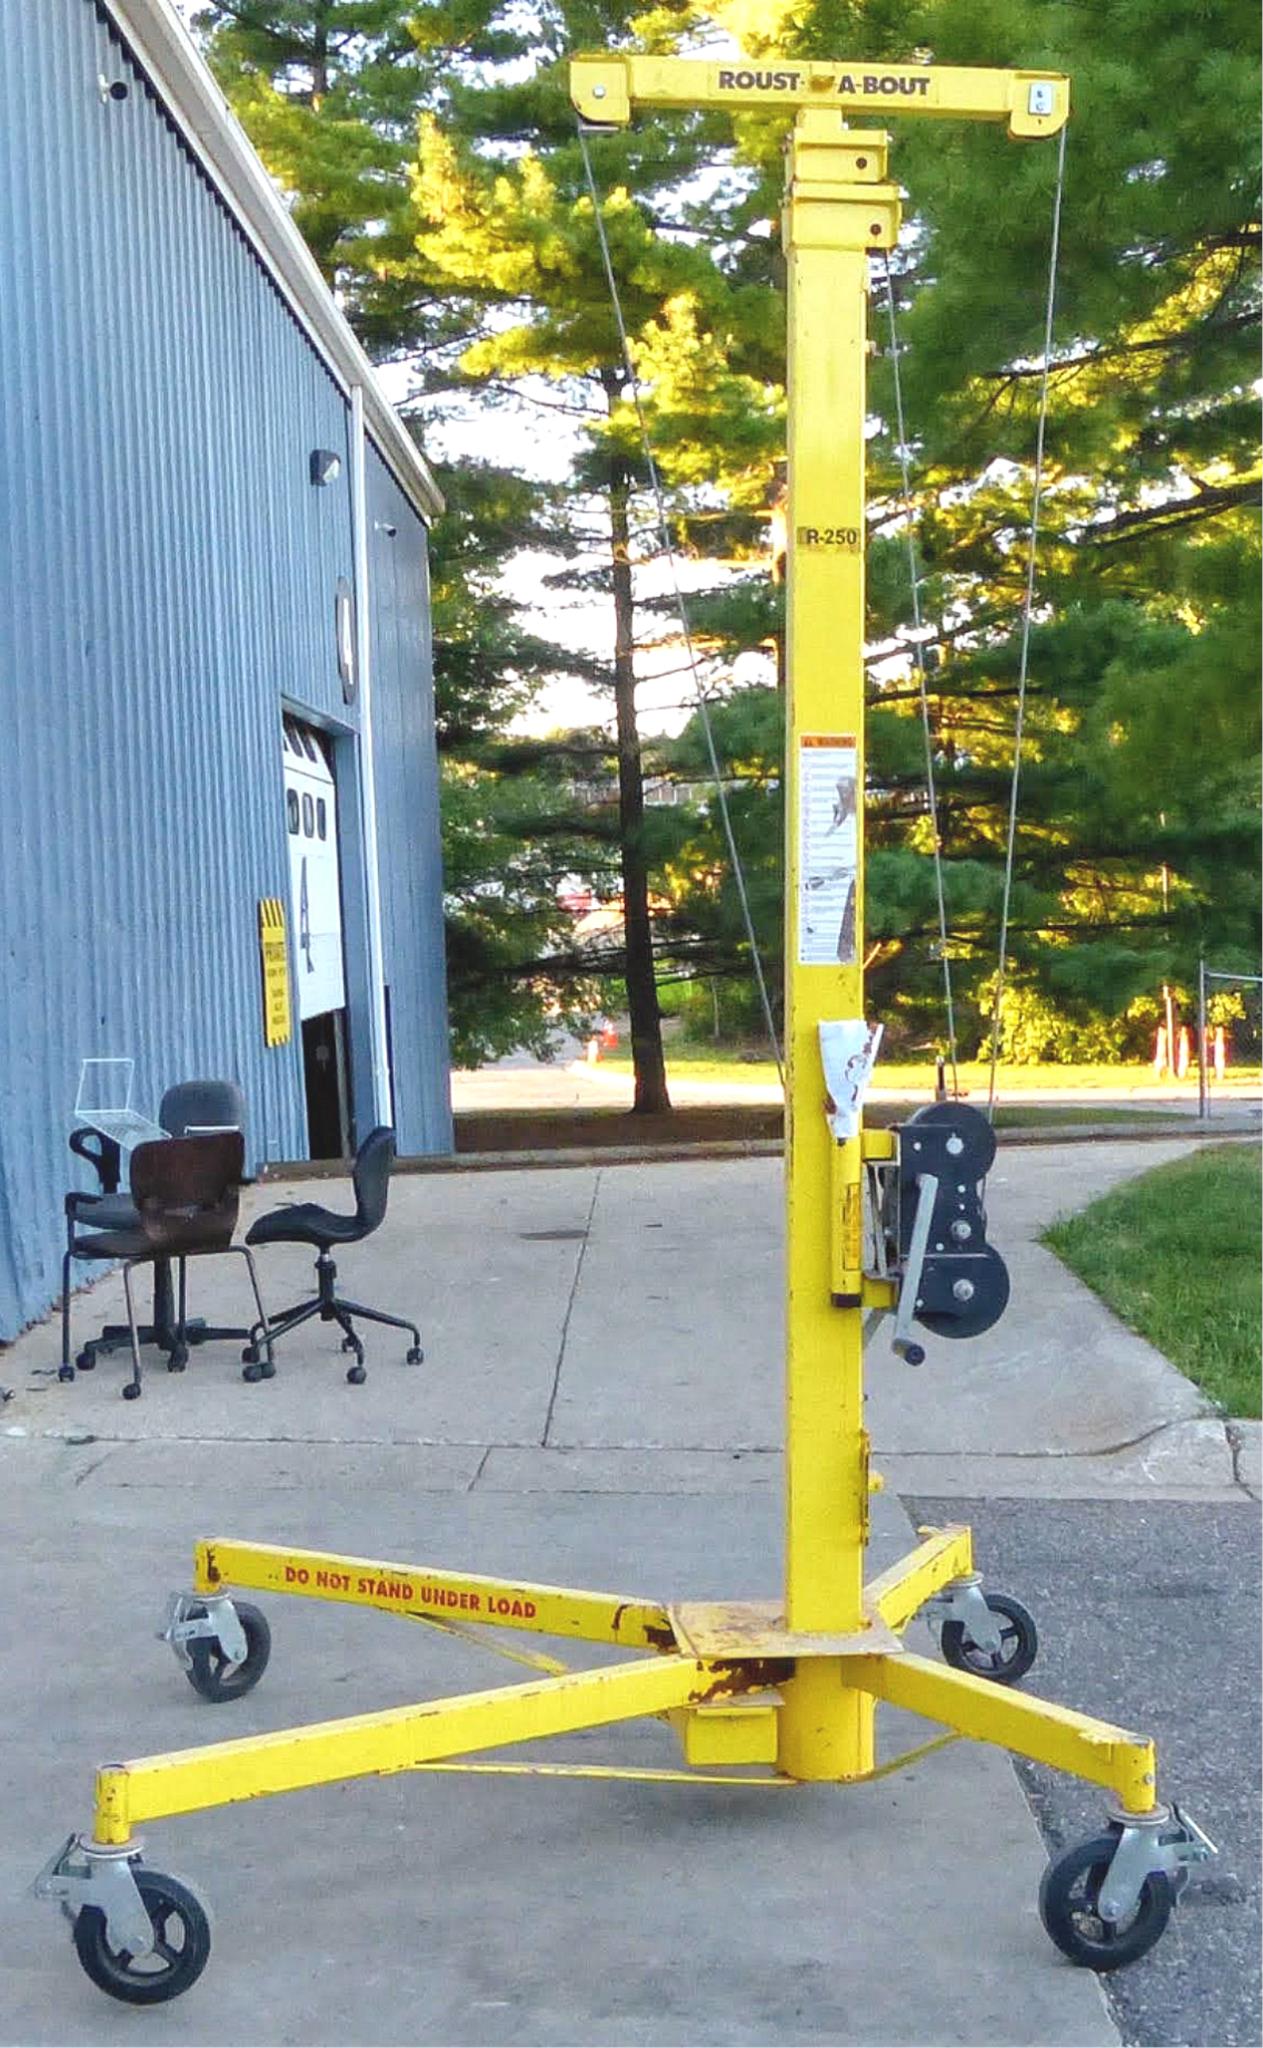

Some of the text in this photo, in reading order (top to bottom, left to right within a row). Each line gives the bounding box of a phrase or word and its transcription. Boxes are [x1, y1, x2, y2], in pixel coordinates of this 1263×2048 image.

[806, 528, 857, 545] R-250
[285, 1565, 536, 1619] DO NOT STAND UNDER LOAD
